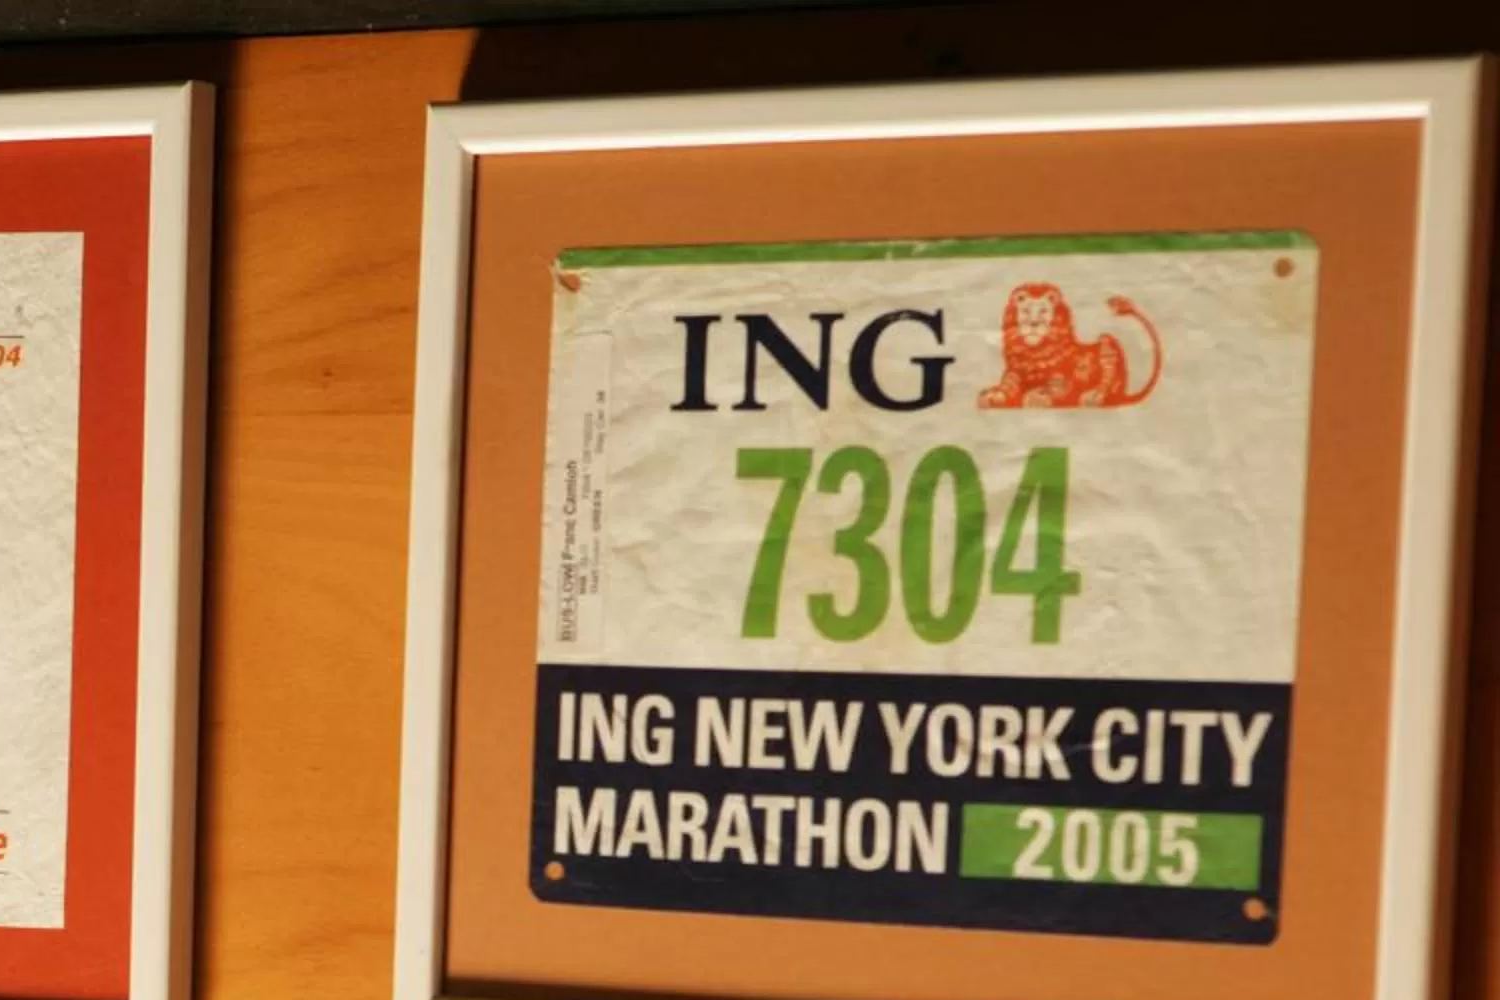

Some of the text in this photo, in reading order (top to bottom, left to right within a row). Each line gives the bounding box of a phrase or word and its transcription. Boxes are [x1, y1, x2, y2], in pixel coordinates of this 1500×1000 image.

[671, 308, 955, 413] ING
[735, 445, 1080, 645] 7304
[556, 692, 1272, 788] ING NEW YORK CITY
[553, 787, 1201, 887] MARATHON 2005
